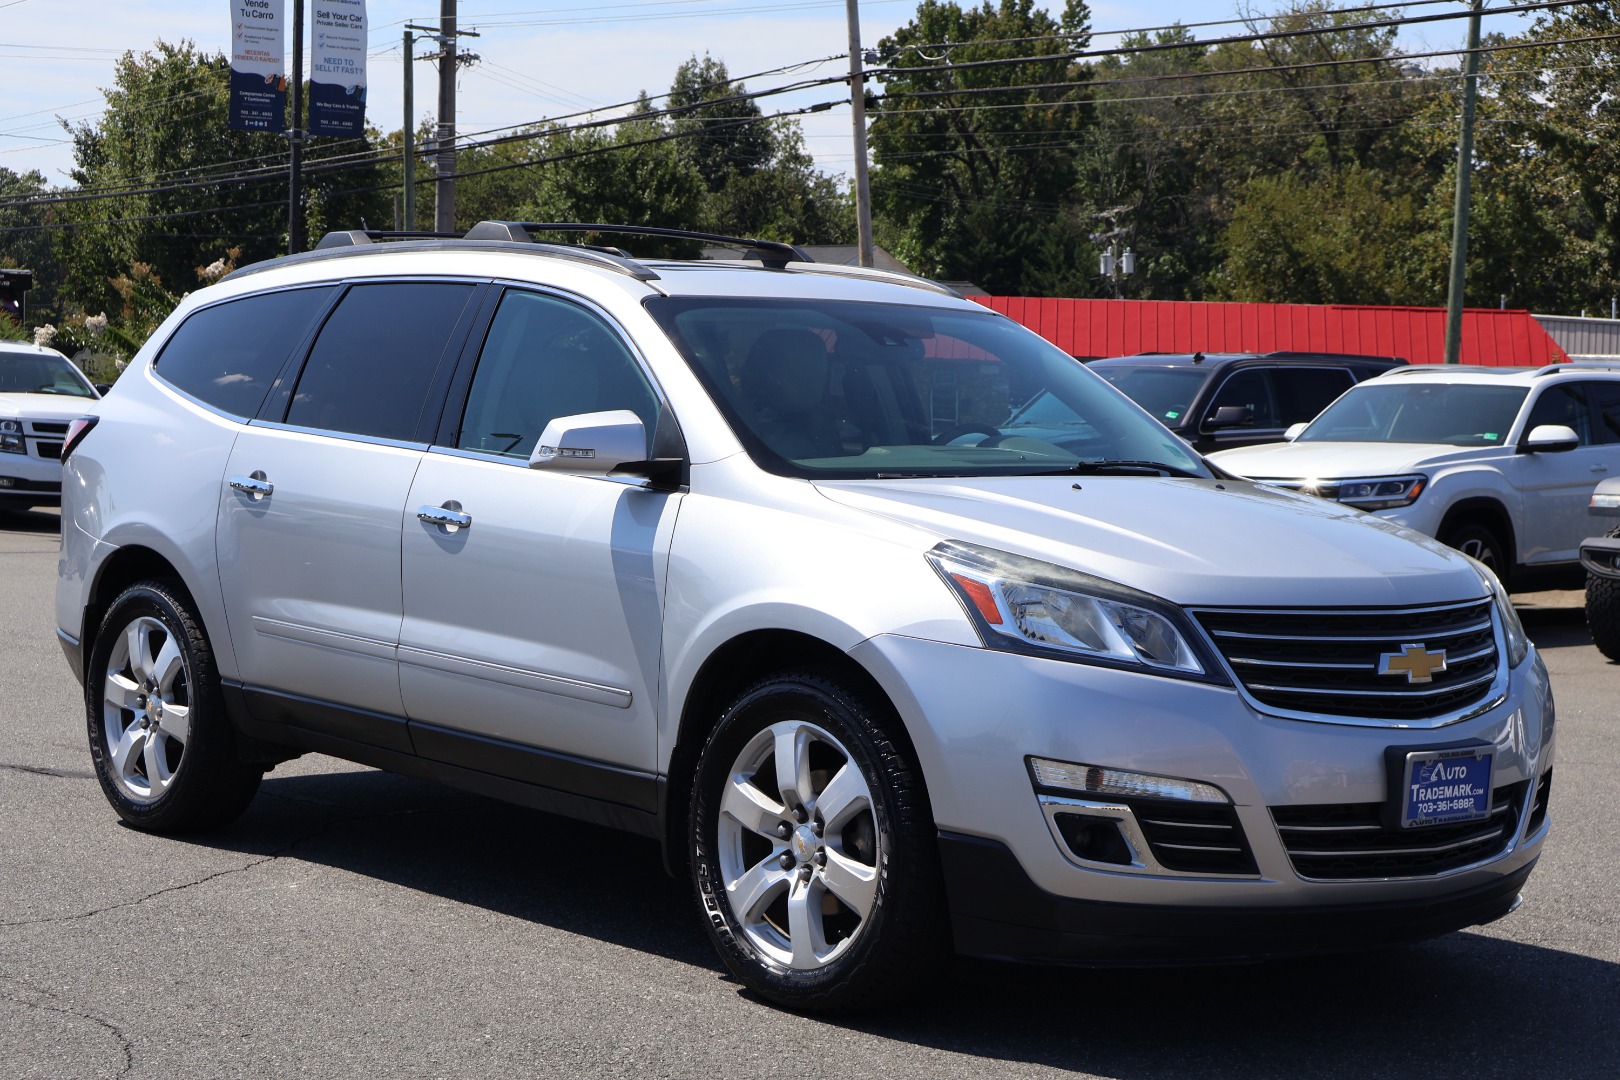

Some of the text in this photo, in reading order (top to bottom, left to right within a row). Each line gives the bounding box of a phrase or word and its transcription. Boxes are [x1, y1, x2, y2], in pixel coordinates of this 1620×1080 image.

[244, 0, 269, 9] Vende
[240, 9, 274, 20] Tu Carro
[316, 10, 363, 22] Sell Your Car
[316, 19, 333, 27] Private
[323, 57, 342, 65] NEED
[315, 64, 332, 72] SELL
[341, 66, 364, 75] FAST?
[1417, 798, 1474, 813] 703-361-6882
